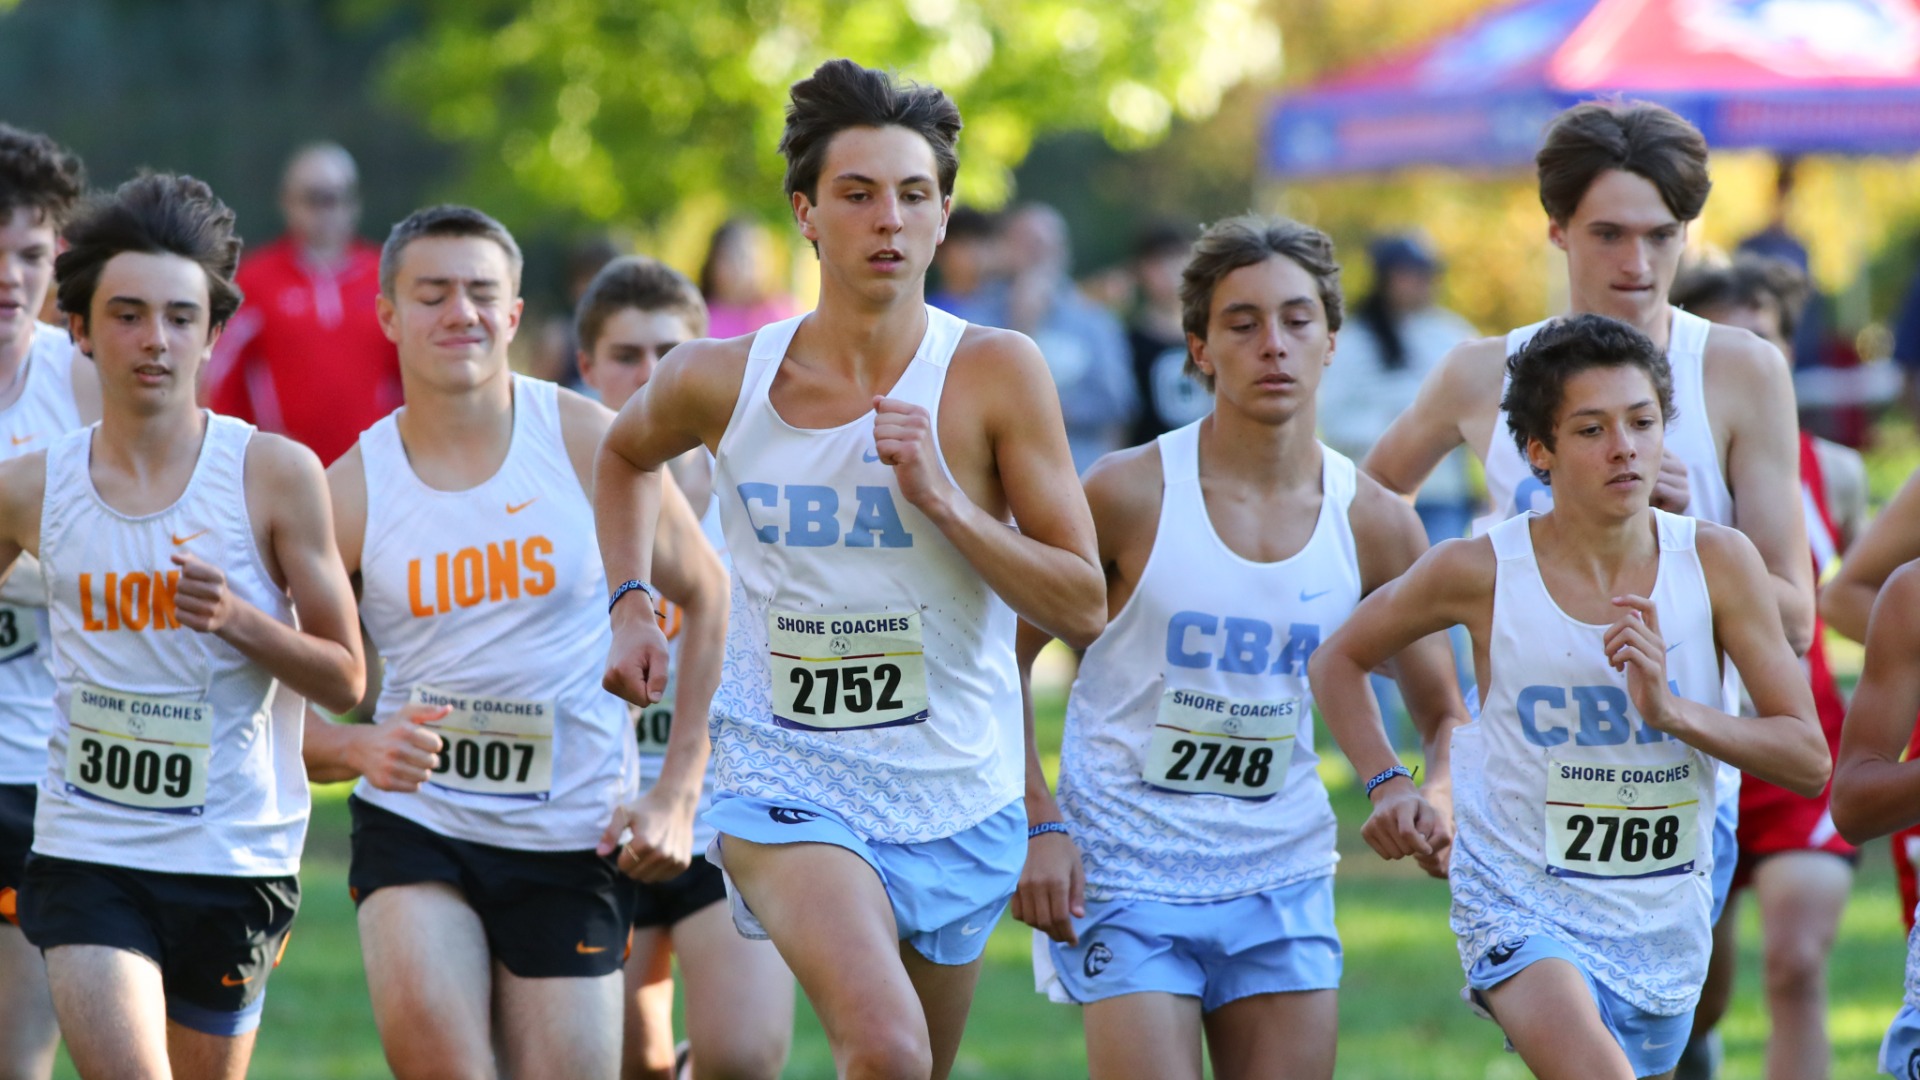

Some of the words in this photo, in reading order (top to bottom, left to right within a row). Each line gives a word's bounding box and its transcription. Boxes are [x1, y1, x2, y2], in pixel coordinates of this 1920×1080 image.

[737, 482, 914, 548] CBA
[408, 534, 556, 618] LIONS
[78, 570, 182, 632] LION
[777, 616, 826, 635] SHORE
[830, 617, 909, 635] COACHES
[1165, 610, 1320, 678] CBA
[81, 690, 126, 713] SHORE
[131, 700, 203, 721] COACHES
[420, 690, 467, 711] SHORE
[473, 700, 544, 716] COACHES
[790, 663, 904, 715] 2752
[1173, 690, 1225, 714] SHORE
[1229, 701, 1294, 718] COACHES
[80, 738, 192, 798] 3009
[1165, 739, 1273, 788] 2748
[1560, 765, 1616, 783] SHORE
[1621, 764, 1690, 784] COACHES
[1564, 814, 1680, 863] 2768
